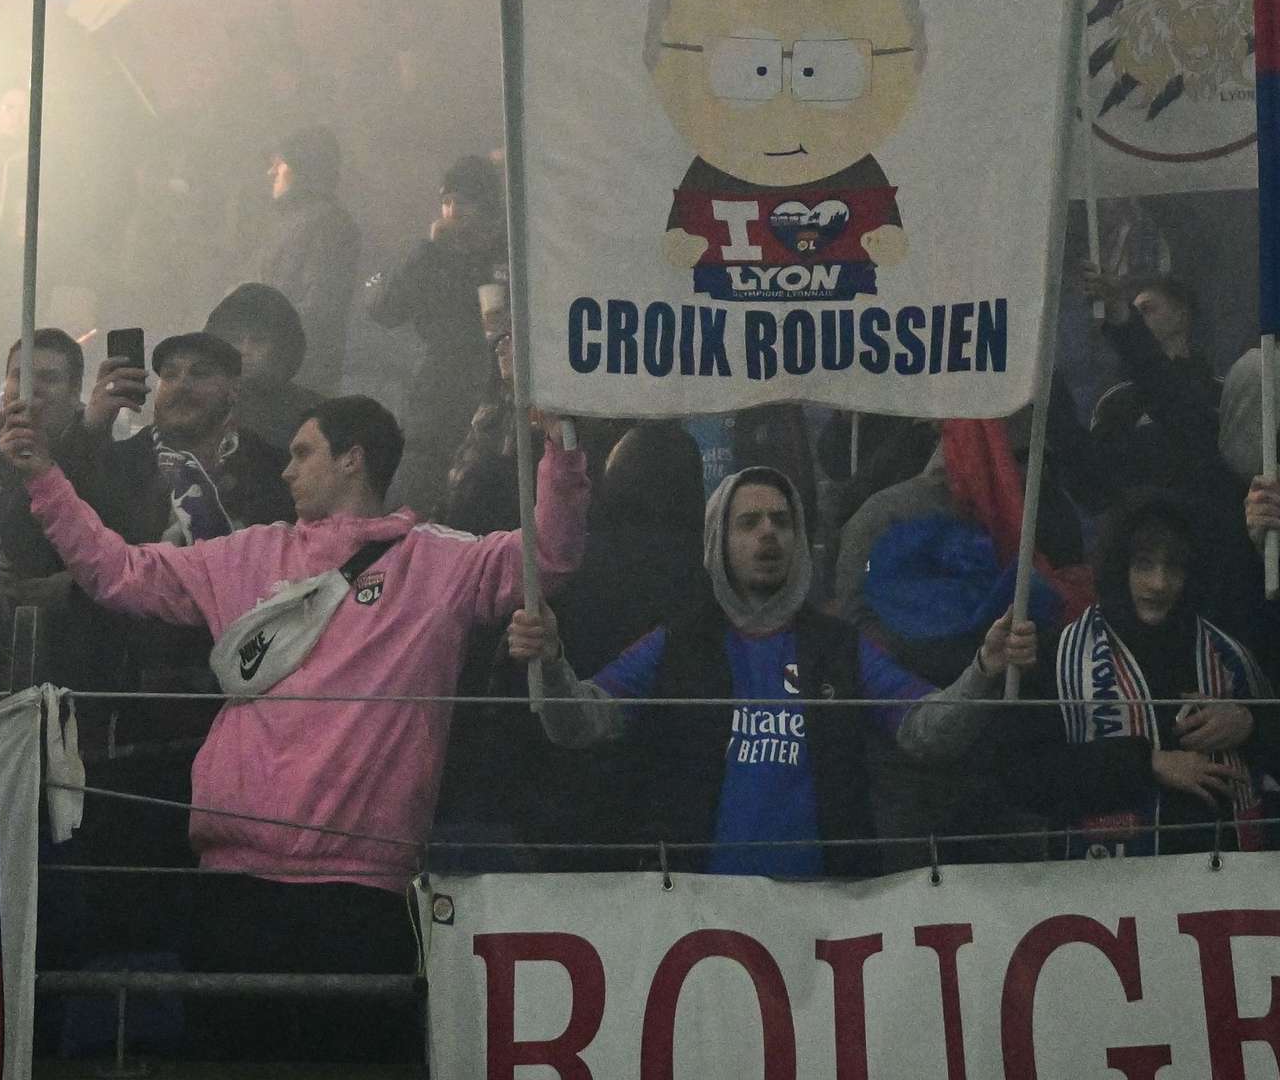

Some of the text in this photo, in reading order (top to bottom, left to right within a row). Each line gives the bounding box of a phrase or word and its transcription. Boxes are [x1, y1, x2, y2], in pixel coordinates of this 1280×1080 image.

[711, 199, 763, 261] I
[725, 264, 842, 291] LYON
[568, 296, 1007, 380] CROIX ROUSSIEN
[239, 631, 266, 666] NIKE
[737, 738, 800, 766] BETTER
